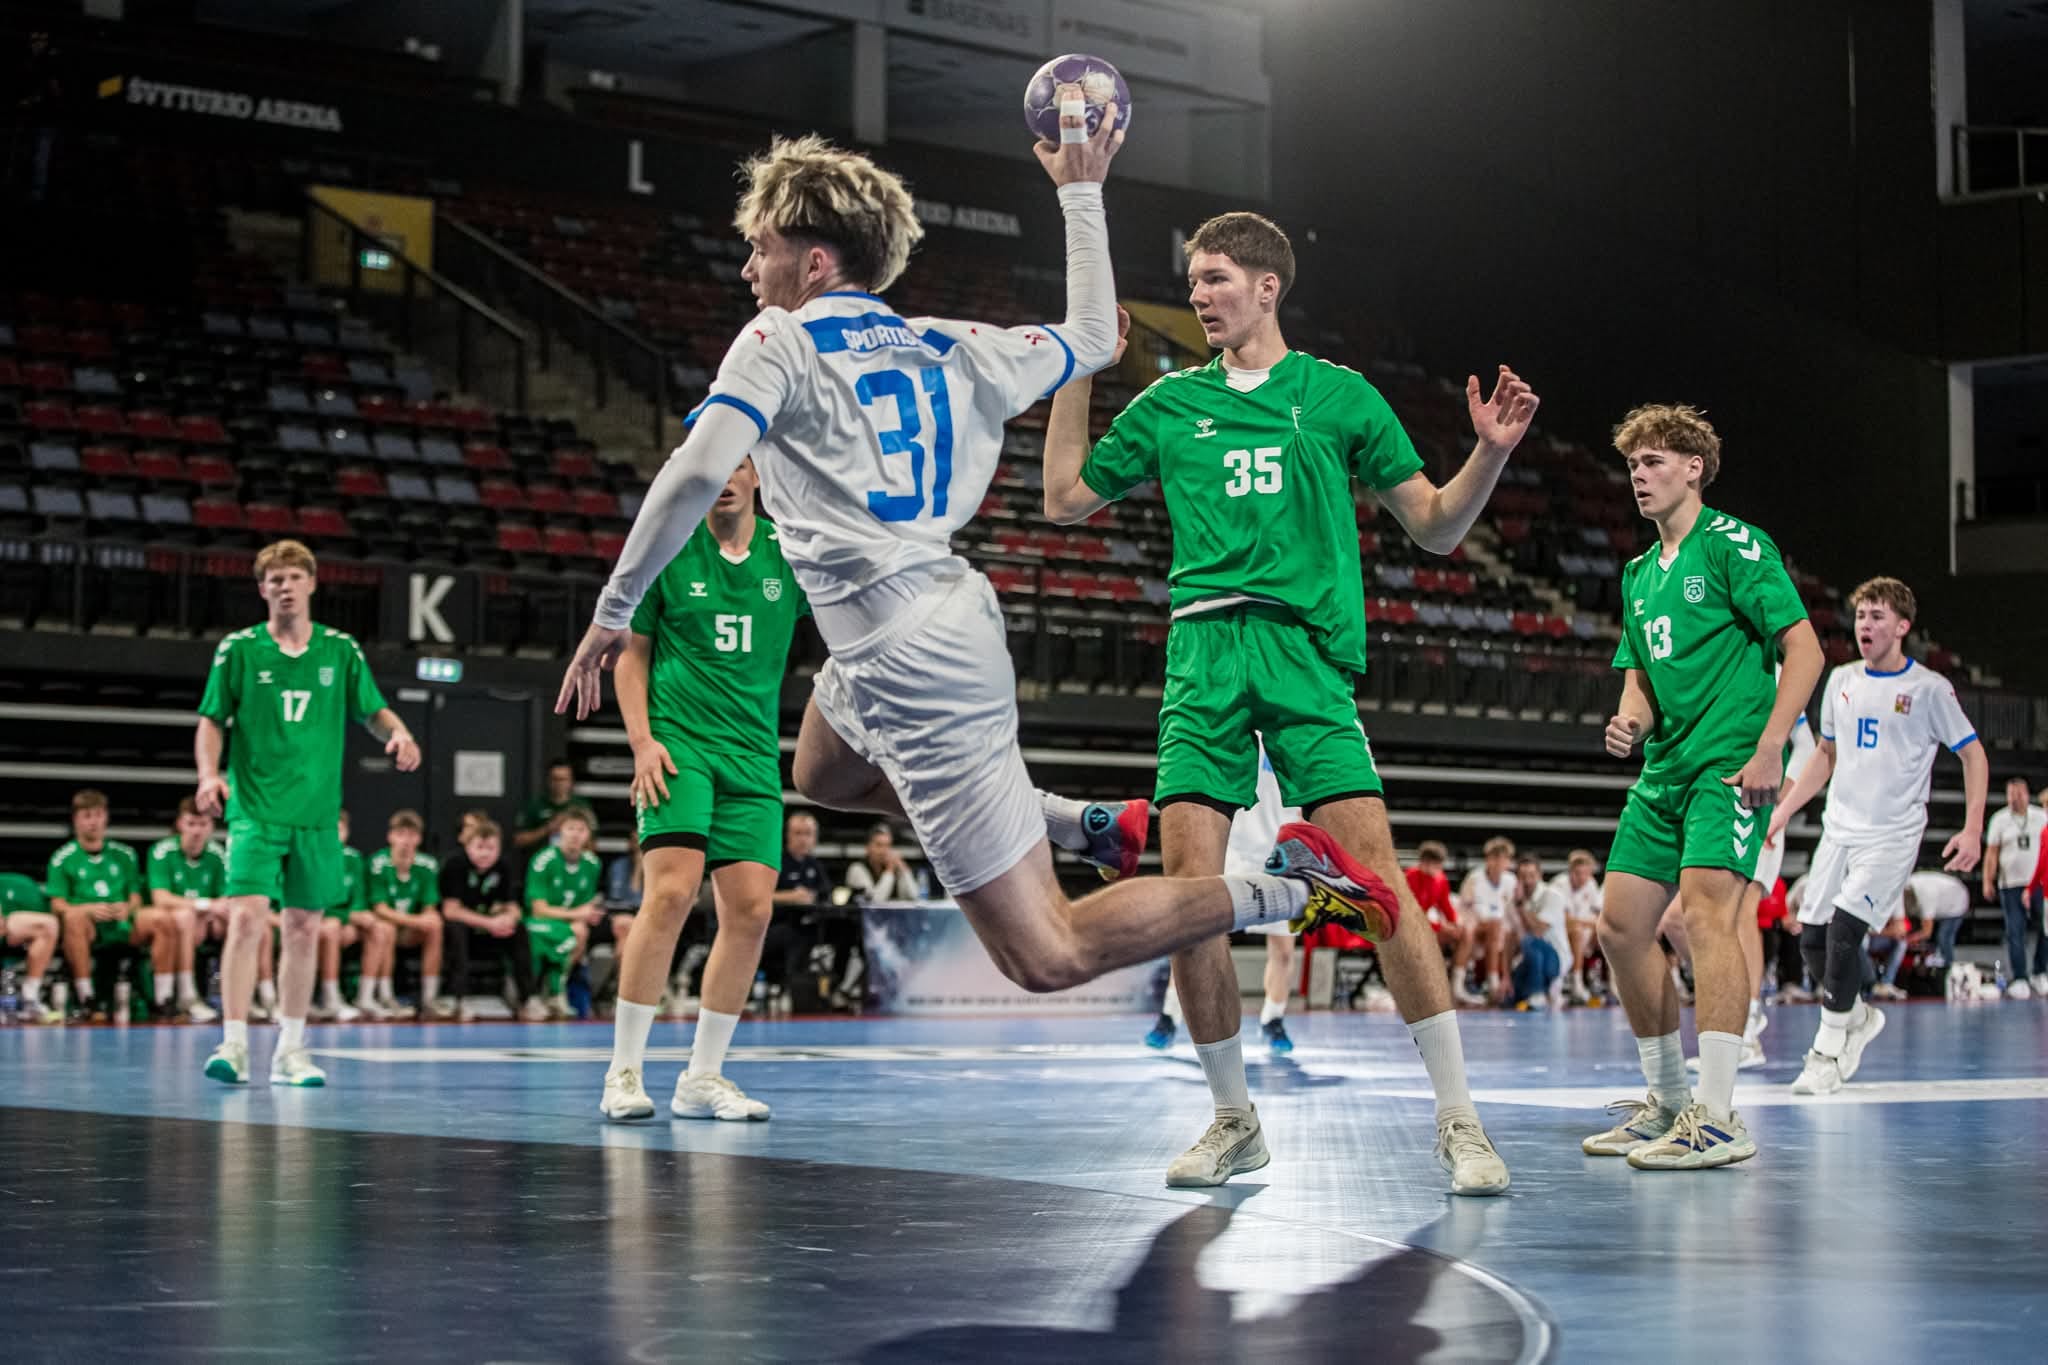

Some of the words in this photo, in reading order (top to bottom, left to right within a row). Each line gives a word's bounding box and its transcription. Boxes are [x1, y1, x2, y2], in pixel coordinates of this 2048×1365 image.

[254, 98, 343, 132] ARENA
[628, 140, 655, 195] L
[854, 365, 954, 523] 31
[1223, 446, 1283, 498] 35
[408, 573, 456, 643] K
[714, 613, 753, 653] 51
[1643, 615, 1673, 664] 13
[280, 690, 313, 722] 17
[1856, 717, 1879, 749] 15
